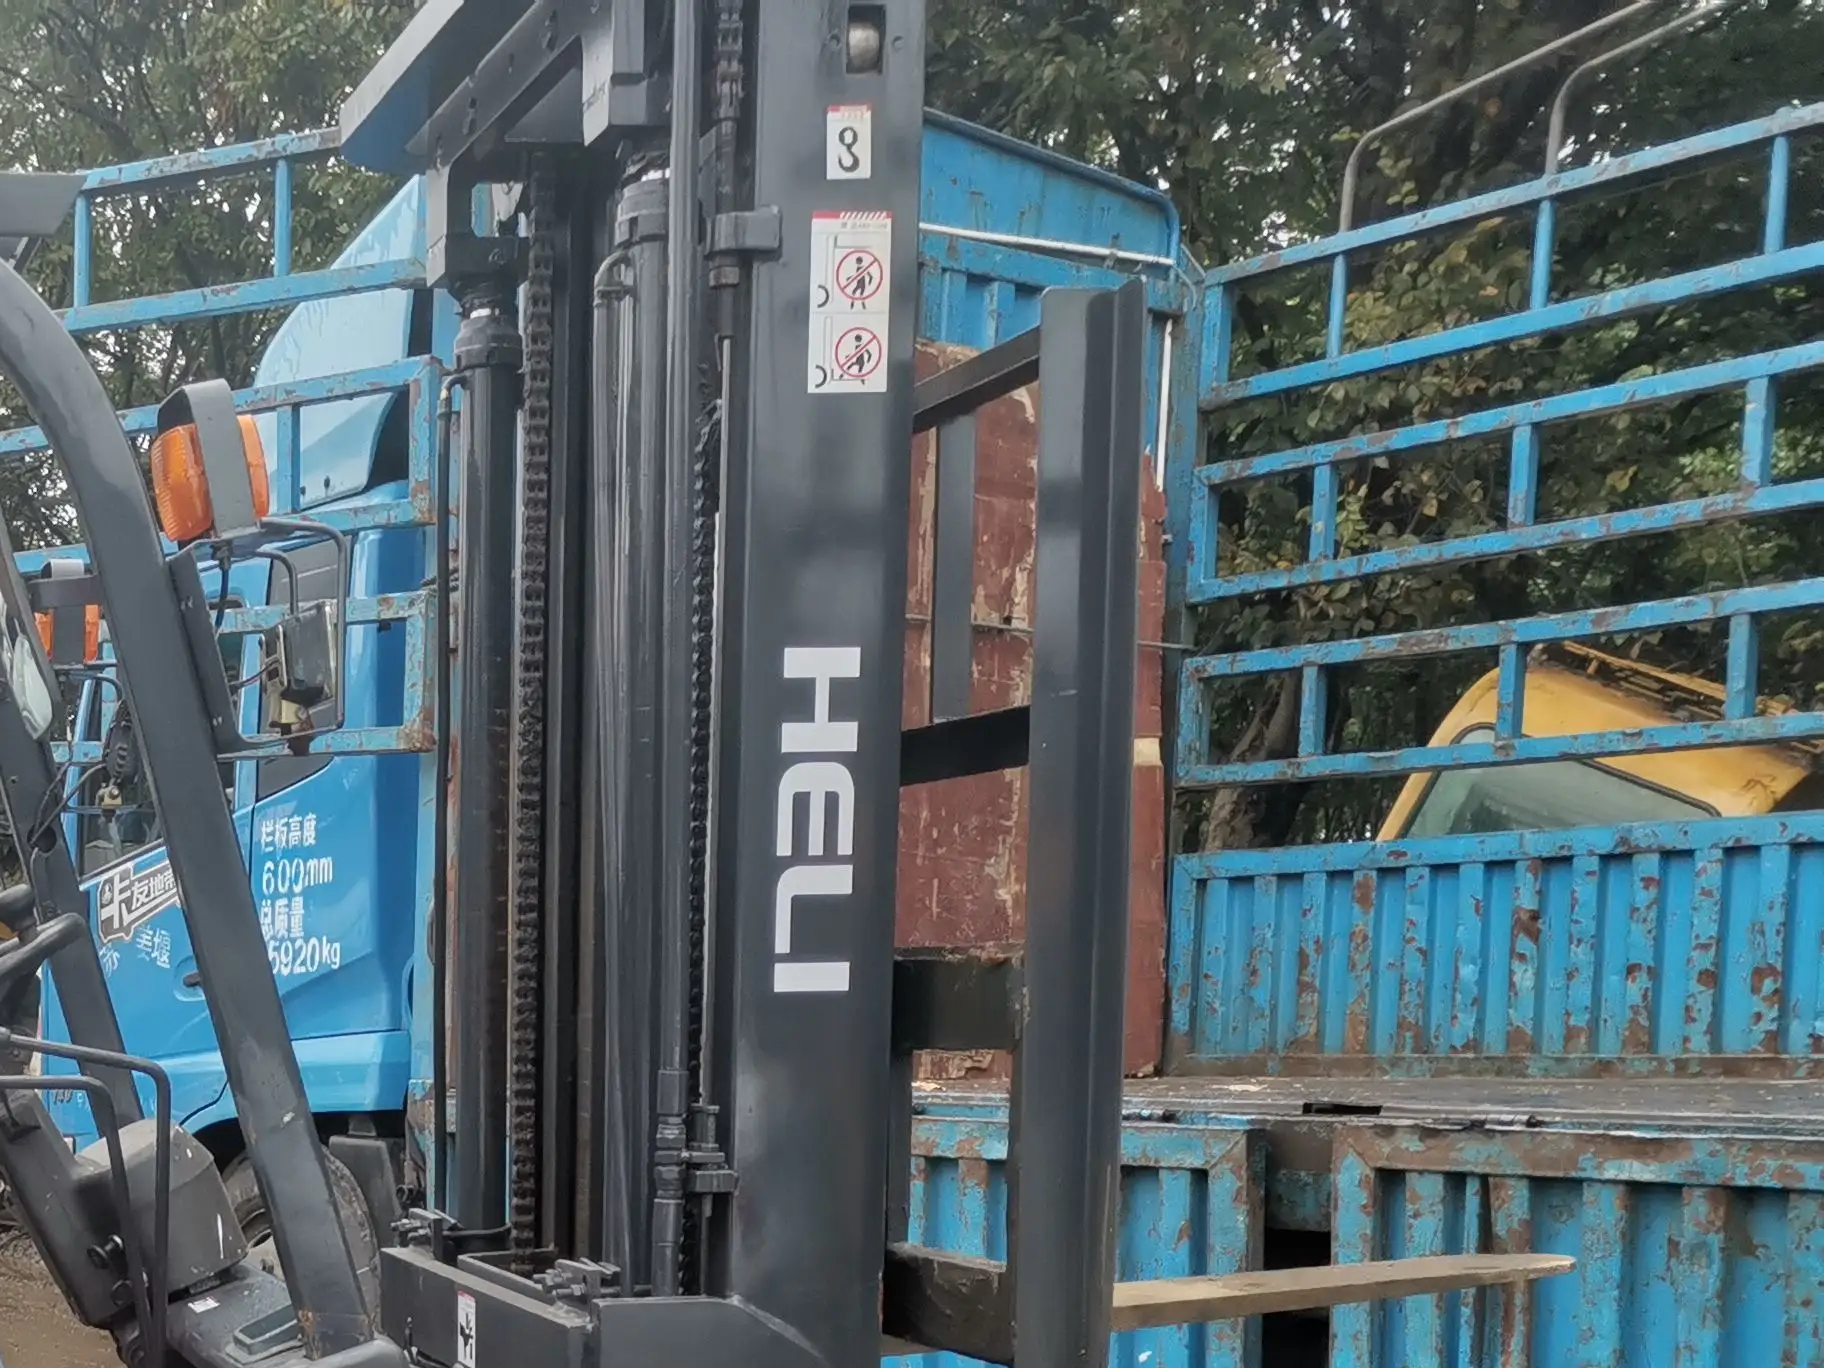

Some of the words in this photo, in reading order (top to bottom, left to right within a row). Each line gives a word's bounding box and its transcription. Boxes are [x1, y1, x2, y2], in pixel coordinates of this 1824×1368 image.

[260, 812, 317, 854] 栏板高度
[774, 647, 861, 992] HELI
[262, 856, 333, 896] 600mm
[260, 896, 305, 942] 总质量
